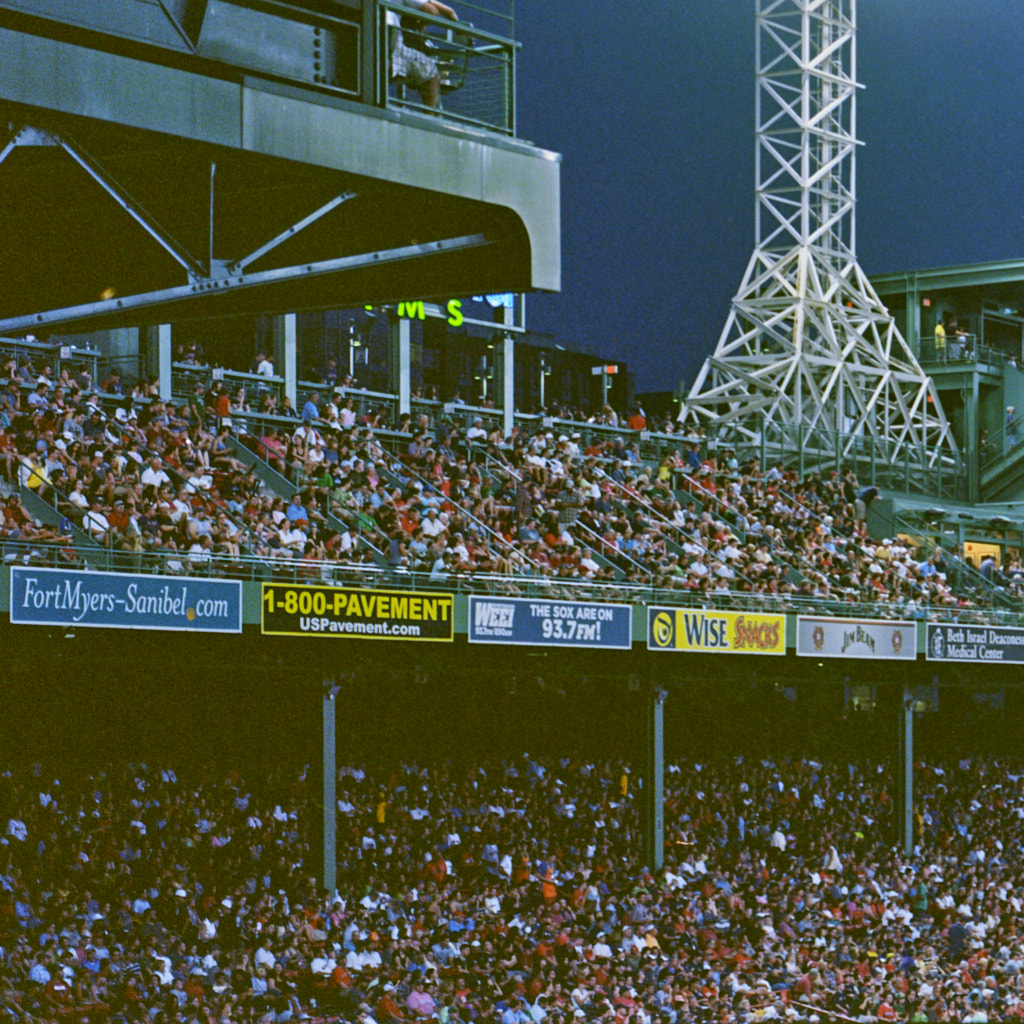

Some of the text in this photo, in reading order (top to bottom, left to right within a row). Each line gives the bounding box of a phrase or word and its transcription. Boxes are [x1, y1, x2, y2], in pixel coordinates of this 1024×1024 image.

[22, 578, 229, 621] FortMyers-Sanibel.com
[264, 589, 451, 621] 1-800-PAVEMENT
[475, 602, 515, 628] WEEI
[529, 604, 613, 622] THE SOX ARE ON
[300, 617, 421, 636] USPavement.com
[542, 619, 602, 641] 93.7FM!
[683, 613, 780, 650] WISE SNACKS
[947, 628, 965, 643] Beth
[966, 629, 987, 644] Israel
[841, 625, 876, 654] JIM BEAM
[947, 644, 1004, 660] Medical Center
